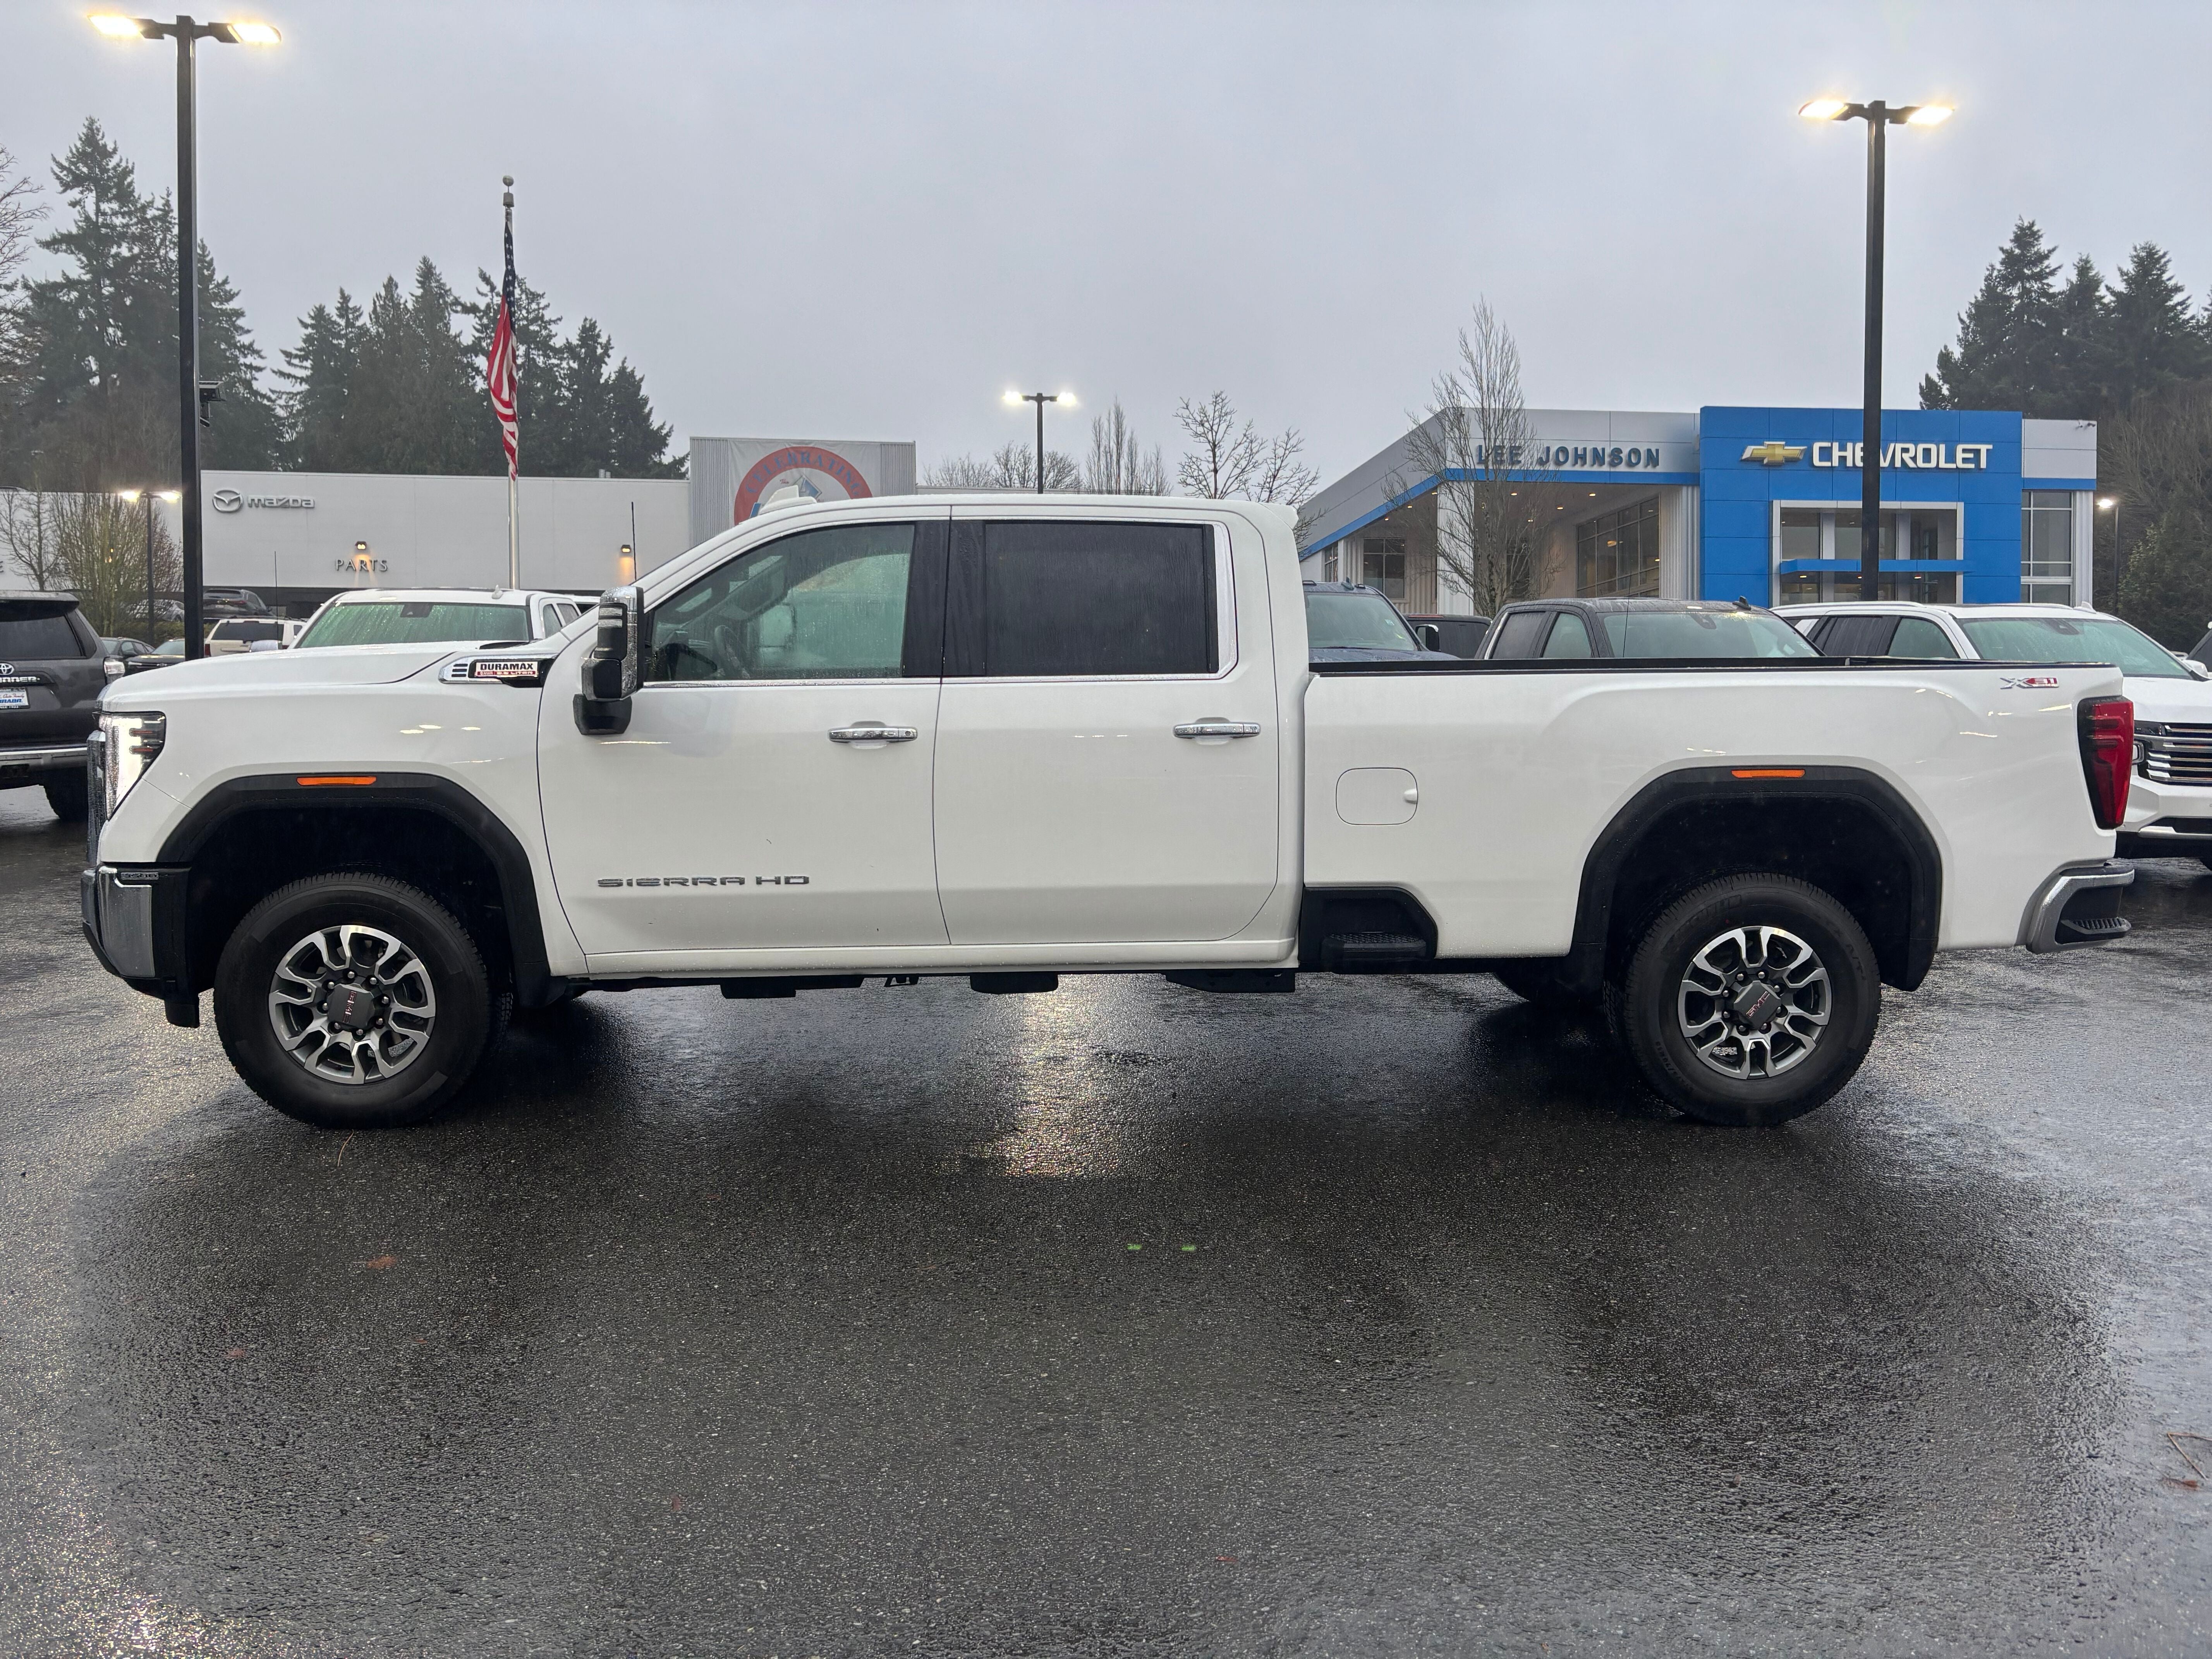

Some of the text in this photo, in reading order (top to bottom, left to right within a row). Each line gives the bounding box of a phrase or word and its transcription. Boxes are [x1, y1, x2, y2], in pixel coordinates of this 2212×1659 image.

[1477, 445, 1660, 467] LEE JOHNSON
[745, 450, 865, 496] CELEBRATING
[335, 559, 388, 572] PARTS
[597, 876, 809, 886] SIERRA HD
[1746, 991, 1770, 1018] GMC
